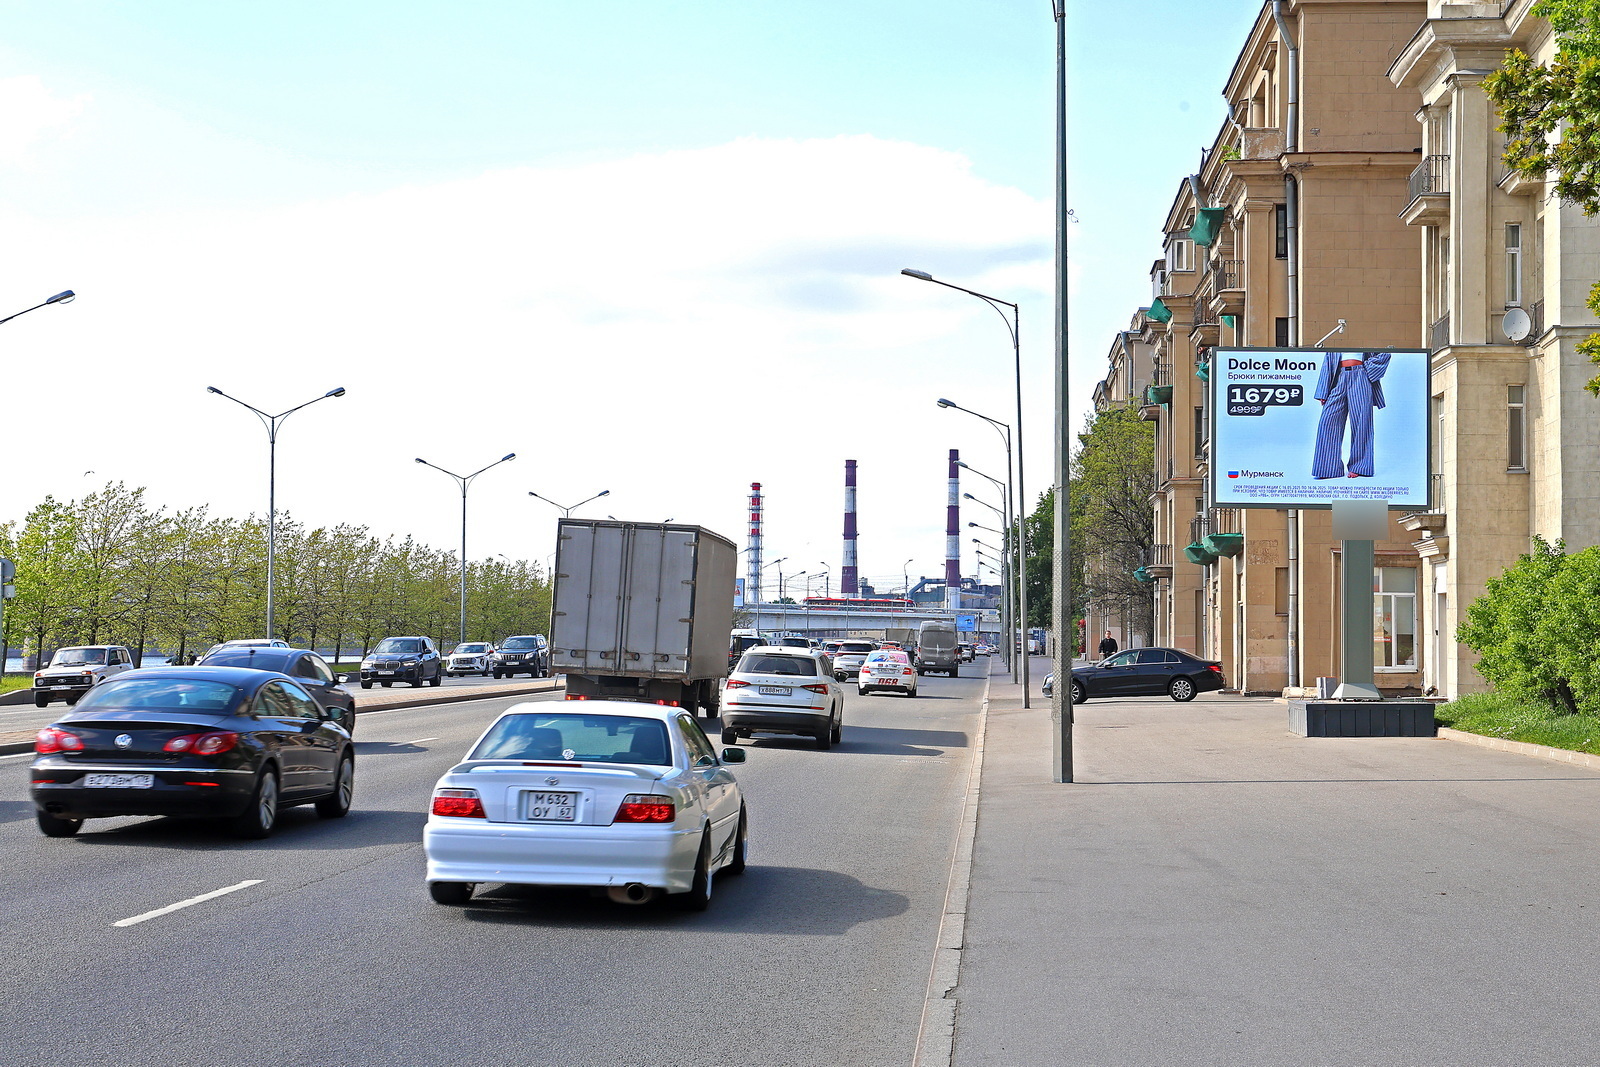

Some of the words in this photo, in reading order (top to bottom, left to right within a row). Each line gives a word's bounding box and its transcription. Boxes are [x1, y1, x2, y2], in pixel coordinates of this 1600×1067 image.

[1228, 358, 1270, 370] Dolce
[1274, 358, 1316, 370] Moon
[1228, 372, 1256, 381] Брюки
[1241, 470, 1284, 478] Мурманск
[532, 807, 550, 817] ОУ
[560, 808, 572, 816] 67
